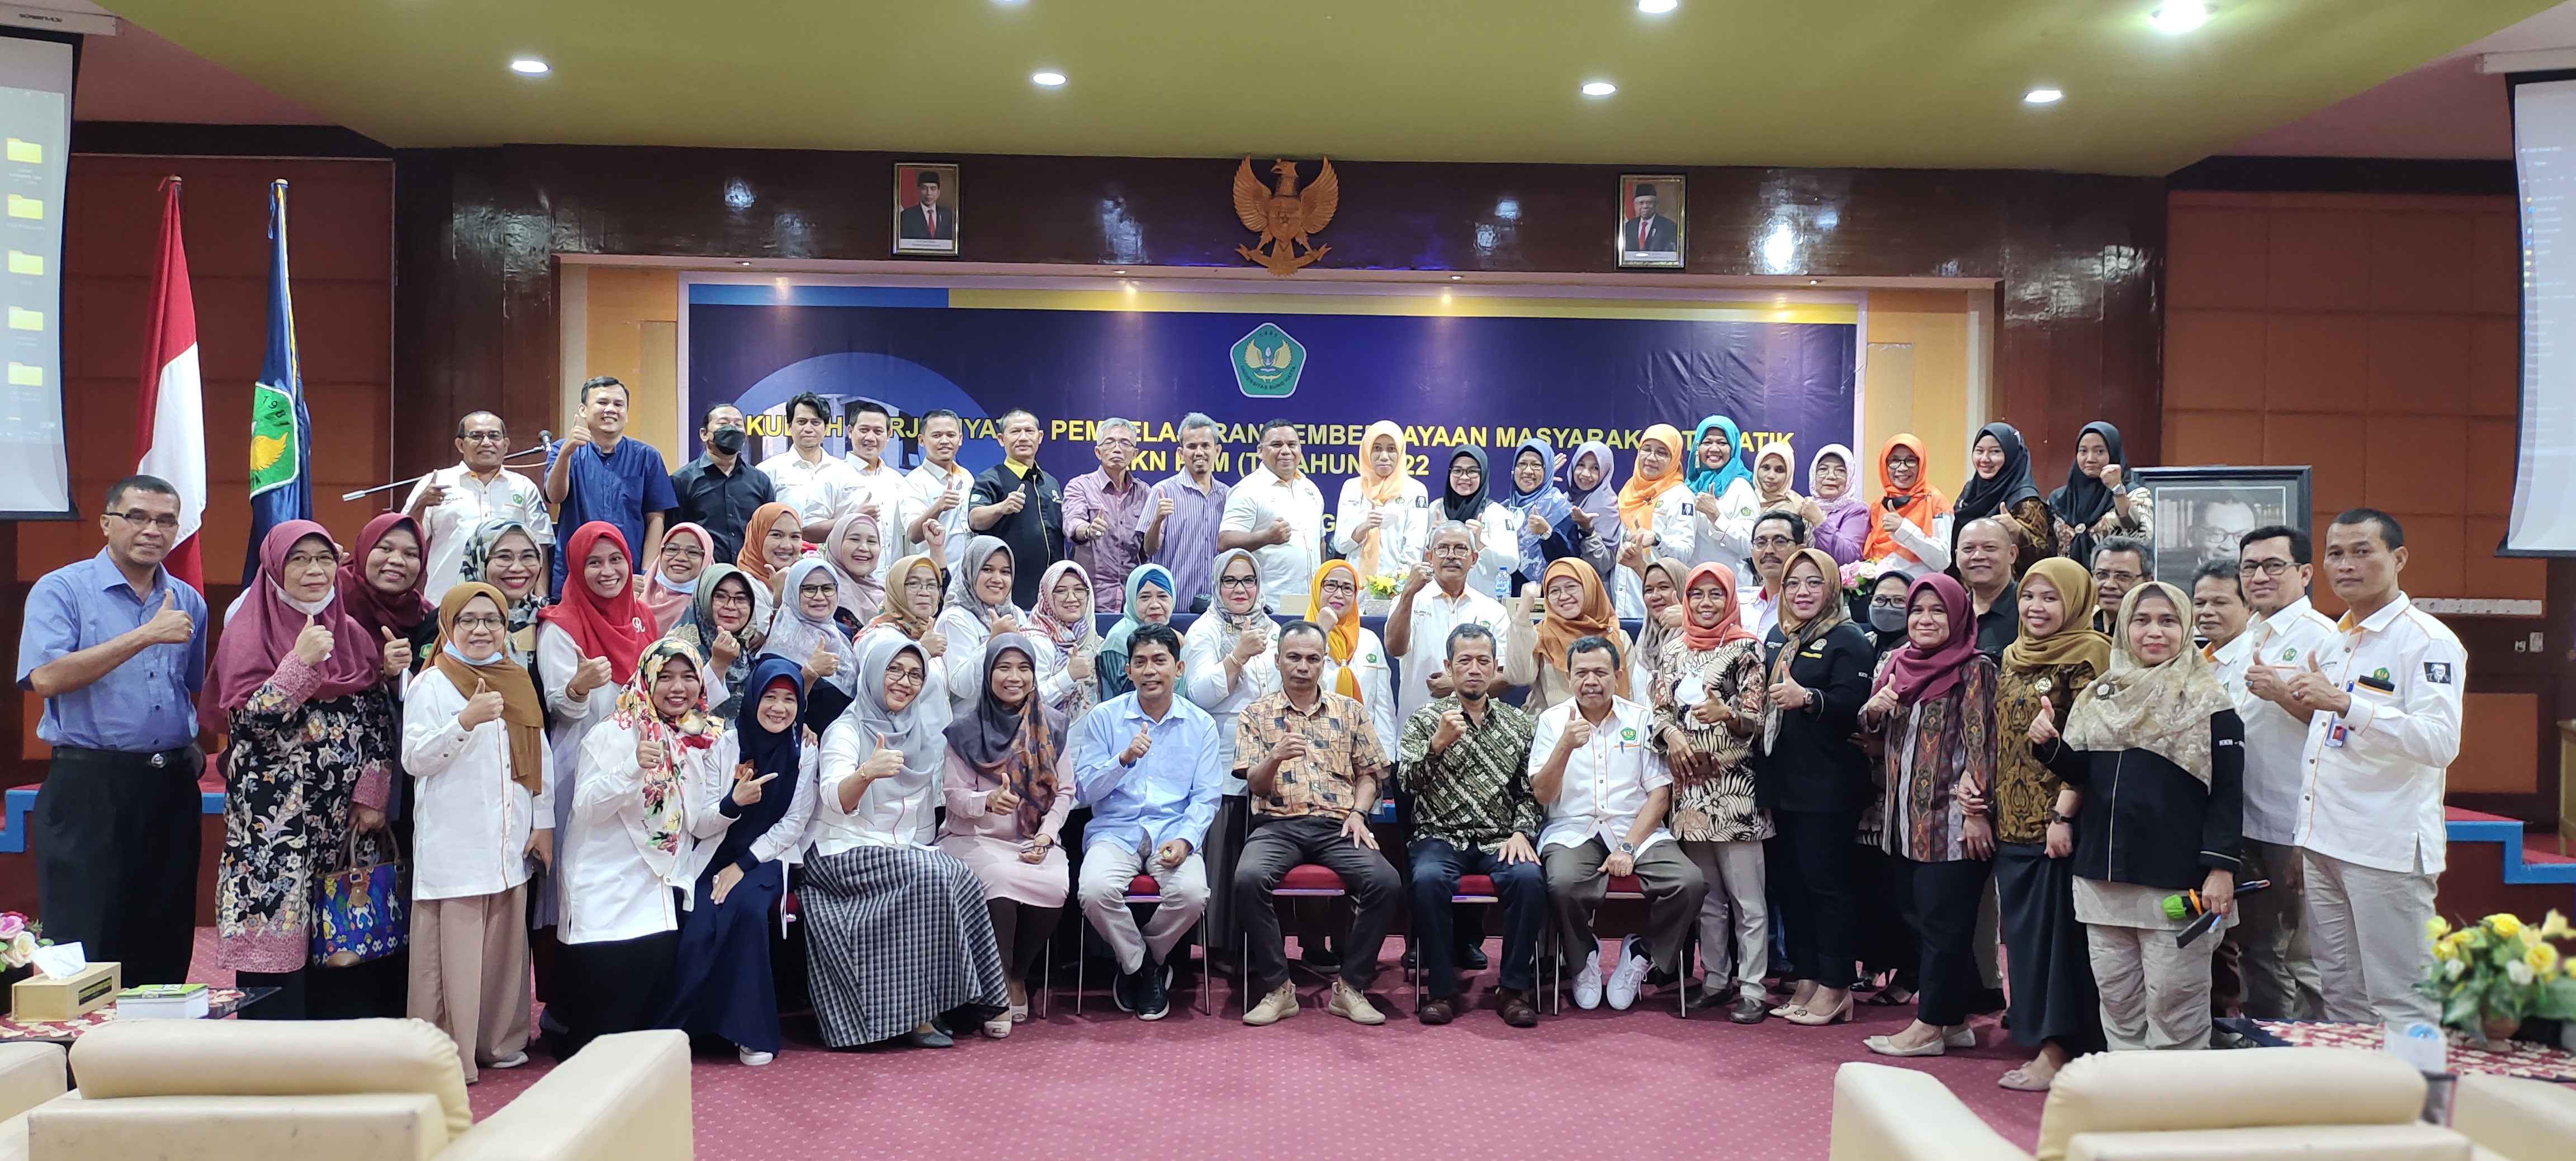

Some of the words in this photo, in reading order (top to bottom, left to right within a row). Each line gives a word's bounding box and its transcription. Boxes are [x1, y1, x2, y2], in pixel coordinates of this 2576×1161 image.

[746, 415, 842, 437] KULH
[1051, 420, 1263, 443] PEMLARAN
[1293, 424, 1487, 447] MBEAYAAN
[1495, 427, 1642, 450] MASYARAK
[1682, 430, 1795, 452] TATIK
[1126, 450, 1166, 471] KN
[1296, 453, 1361, 474] AHUN
